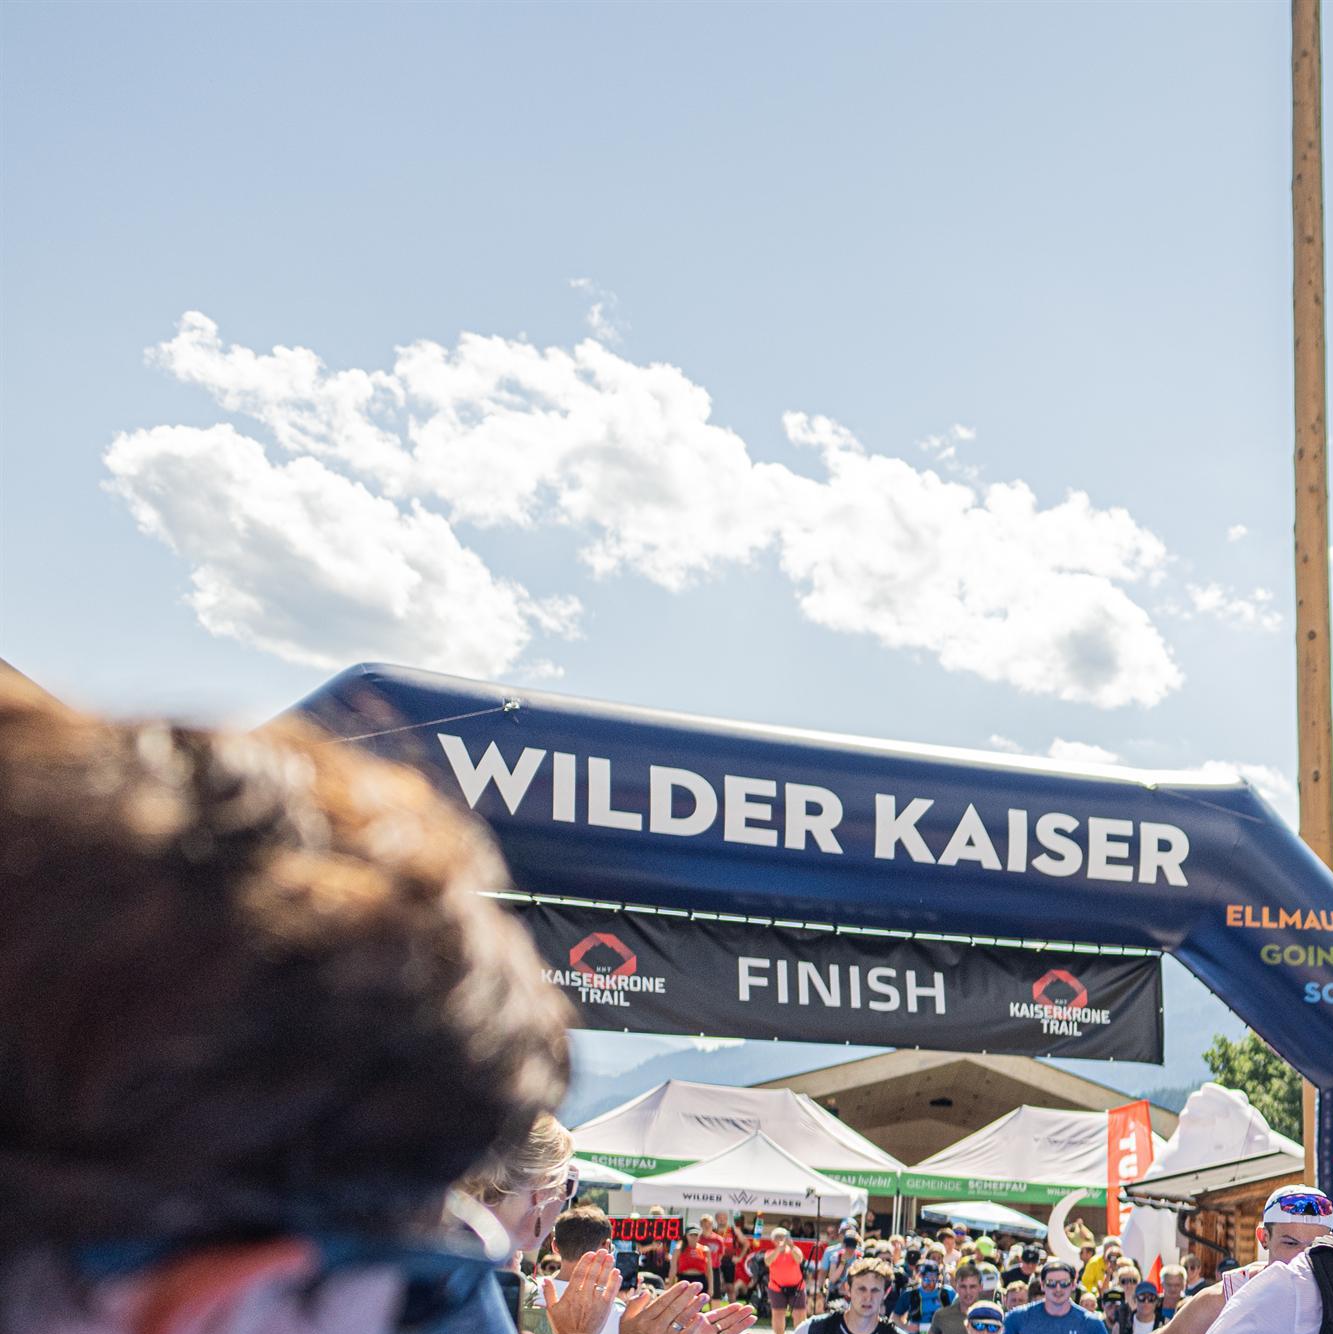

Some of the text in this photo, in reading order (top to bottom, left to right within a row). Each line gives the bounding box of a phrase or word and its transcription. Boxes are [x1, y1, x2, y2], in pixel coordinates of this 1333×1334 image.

[437, 733, 1190, 888] WILDER KAISER
[541, 968, 666, 994] KAISERKRONE
[738, 956, 947, 1015] FINISH
[578, 986, 631, 1008] TRAIL
[1009, 1002, 1111, 1025] KAISERKRONE
[1040, 1019, 1083, 1037] TRAIL
[591, 1154, 657, 1169] SCHEFFAU
[906, 1178, 963, 1192] GEMEINDE
[968, 1180, 1028, 1193] SCHEFFAU
[682, 1192, 802, 1208] WILDER KAISER
